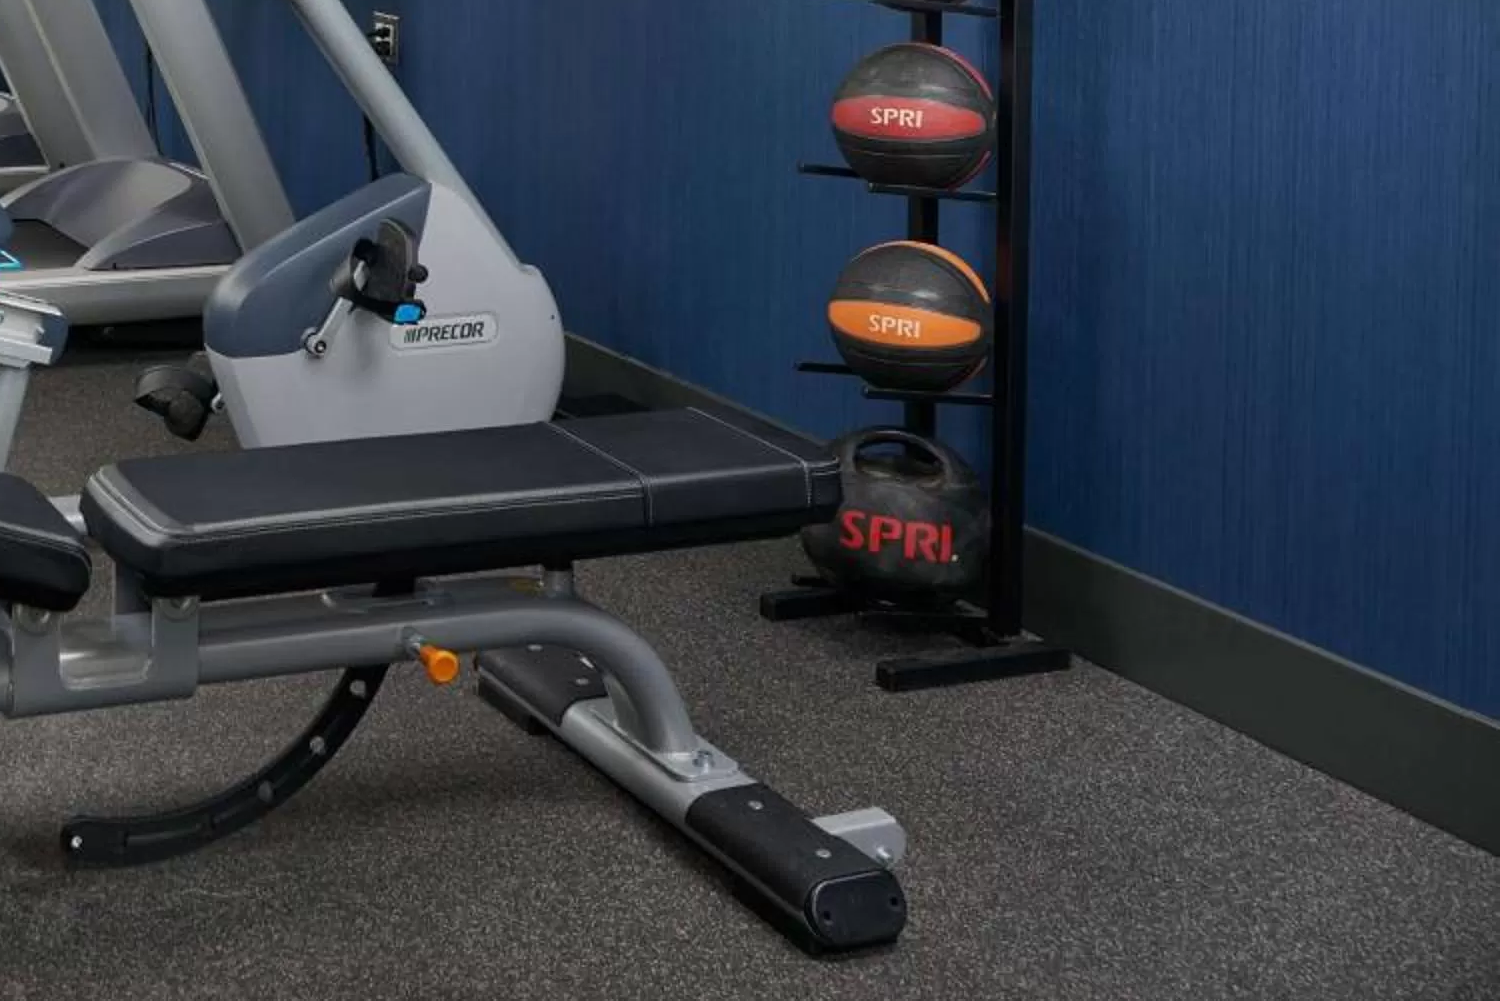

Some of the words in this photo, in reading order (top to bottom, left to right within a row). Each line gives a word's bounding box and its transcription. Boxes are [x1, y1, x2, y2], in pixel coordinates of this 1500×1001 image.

[870, 106, 923, 129] SPRI
[416, 321, 485, 343] PRECOR
[868, 314, 921, 339] SPRI
